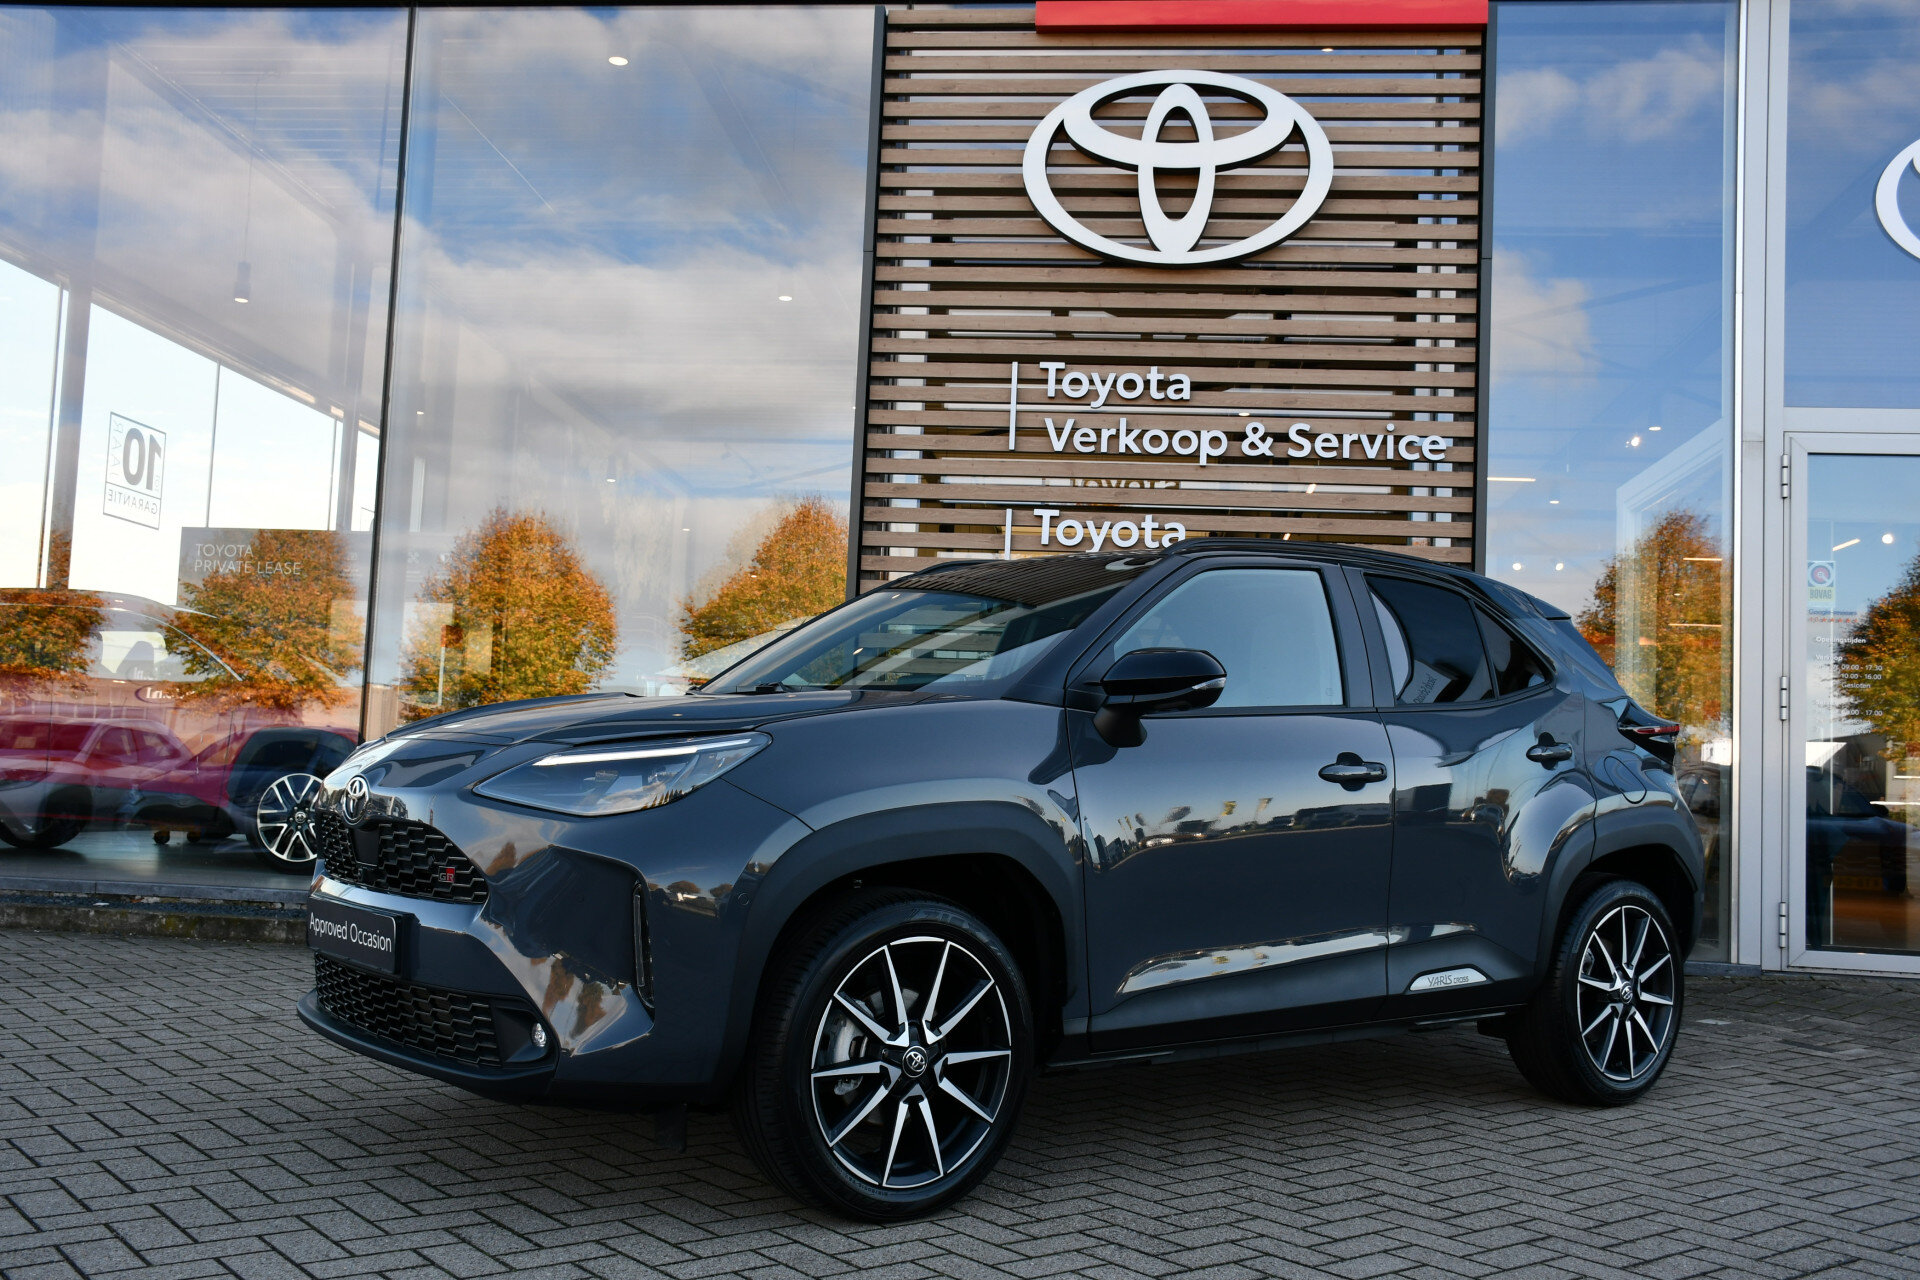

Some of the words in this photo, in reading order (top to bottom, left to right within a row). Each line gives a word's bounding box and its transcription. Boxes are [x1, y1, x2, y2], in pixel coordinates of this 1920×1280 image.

[1039, 361, 1191, 408] Toyota
[1044, 417, 1228, 466] Verkoop
[1241, 421, 1274, 457] &
[1287, 422, 1447, 461] Service
[1033, 508, 1186, 553] Toyota
[195, 543, 254, 558] TOYOTA
[194, 559, 252, 574] PRIVATE
[257, 561, 301, 575] LEASE
[1809, 588, 1832, 600] BOVAG
[309, 911, 348, 940] Approved
[350, 923, 392, 953] Occasion
[1427, 974, 1453, 988] YARIS
[1453, 976, 1469, 984] CROSS
